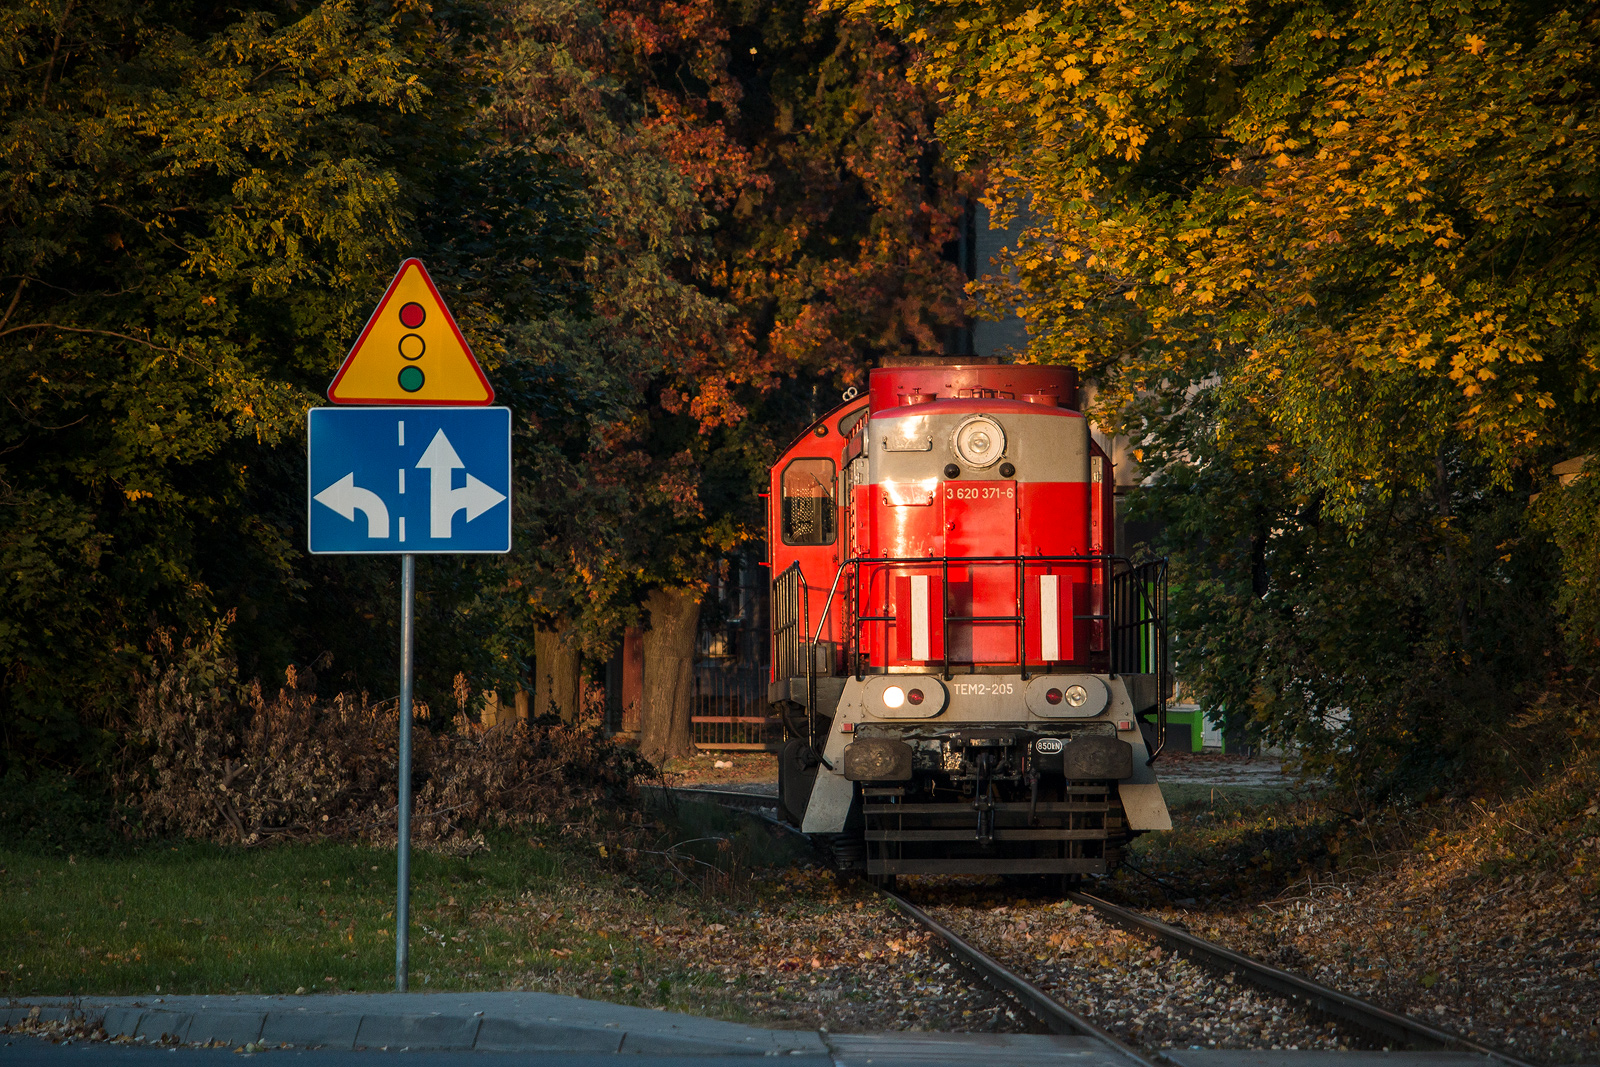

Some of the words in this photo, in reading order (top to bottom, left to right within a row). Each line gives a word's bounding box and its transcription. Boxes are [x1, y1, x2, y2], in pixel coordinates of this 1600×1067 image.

[946, 488, 954, 499] 3
[956, 488, 979, 499] 620
[982, 487, 1014, 499] 371-6
[953, 683, 1013, 695] TEM2-205
